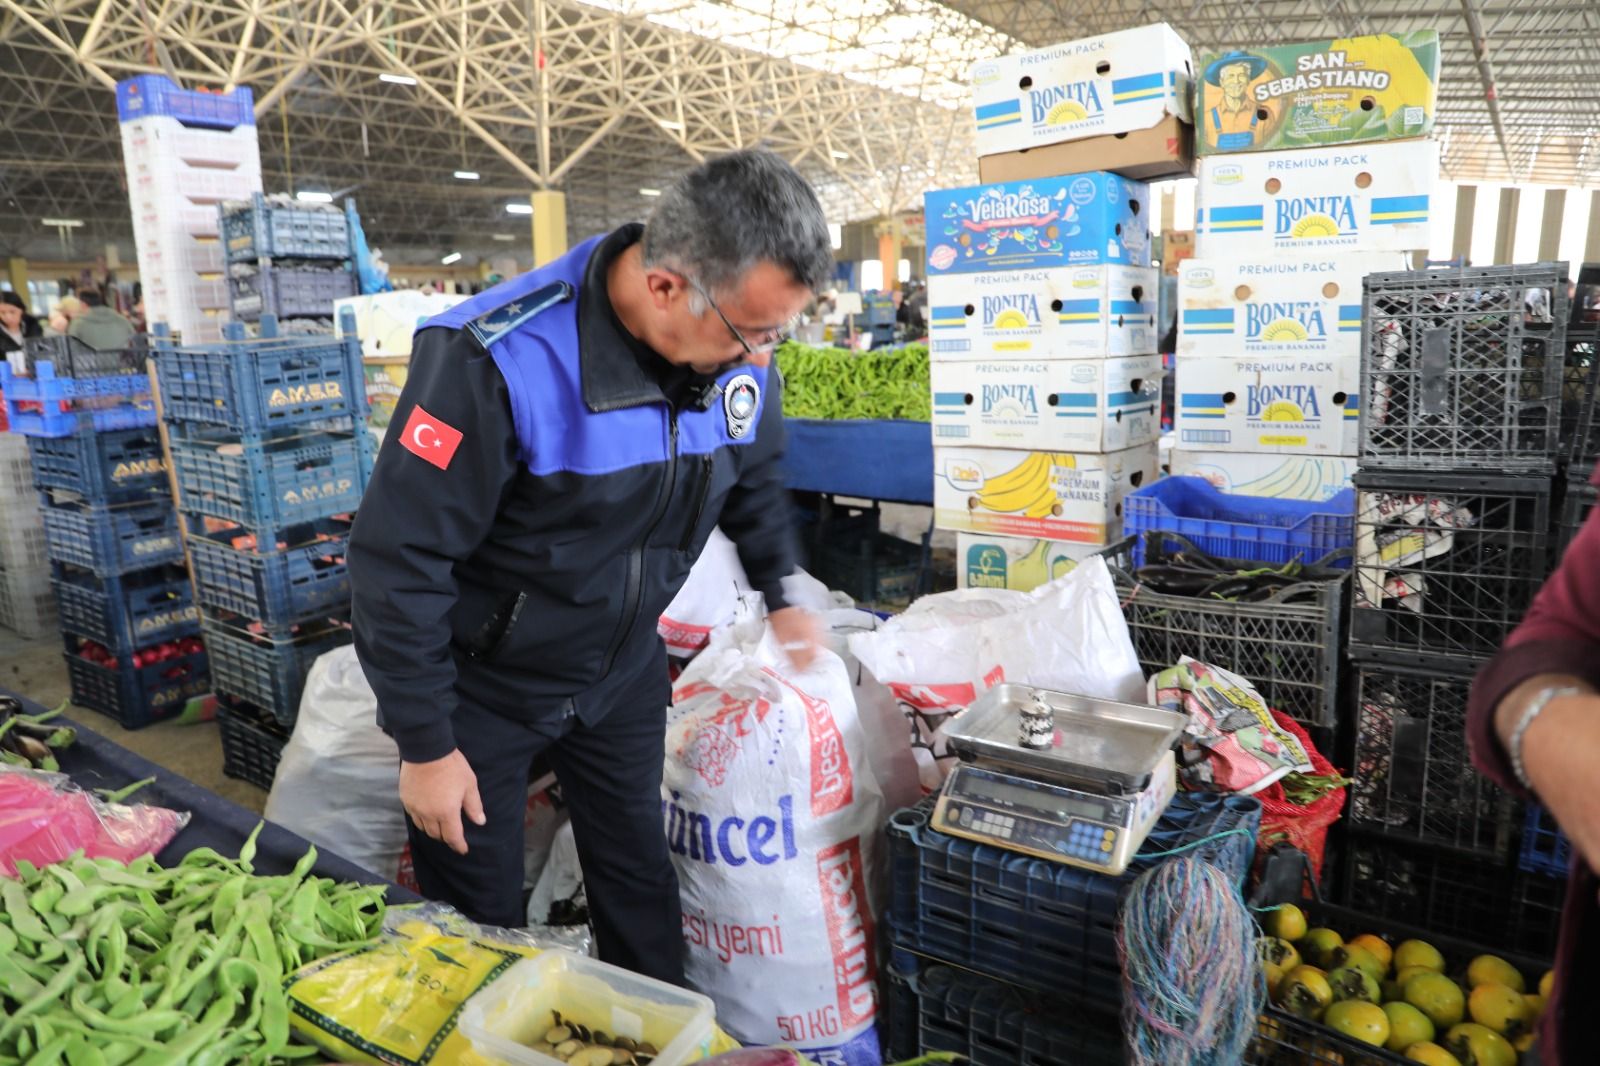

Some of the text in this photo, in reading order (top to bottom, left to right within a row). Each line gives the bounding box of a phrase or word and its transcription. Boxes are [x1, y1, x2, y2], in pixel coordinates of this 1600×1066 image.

[1020, 41, 1105, 66] PREMIUM PACK
[1297, 51, 1345, 71] SAN
[1255, 70, 1389, 101] SEBASTIANO
[1029, 79, 1104, 124] BONITA
[1267, 154, 1369, 170] PREMIUM PACK
[966, 196, 1050, 222] VelaRosa
[1274, 194, 1359, 234] BONITA
[1274, 239, 1314, 248] PREMIUM
[974, 271, 1051, 285] PREMIUM PACK
[1239, 261, 1336, 275] PREMIUM PACK
[981, 293, 1042, 325] BONITA
[1245, 301, 1327, 338] BONITA
[976, 363, 1049, 374] PREMIUM PACK
[1236, 362, 1334, 373] PREMIUM PACK
[981, 384, 1039, 414] BONITA
[1246, 384, 1321, 417] BONITA
[1056, 491, 1101, 502] BANANAS
[1057, 476, 1100, 490] PREMIUM
[815, 727, 845, 799] besi
[661, 789, 798, 868] üncel
[680, 909, 784, 964] esi yemi
[776, 1004, 839, 1042] 50 KG
